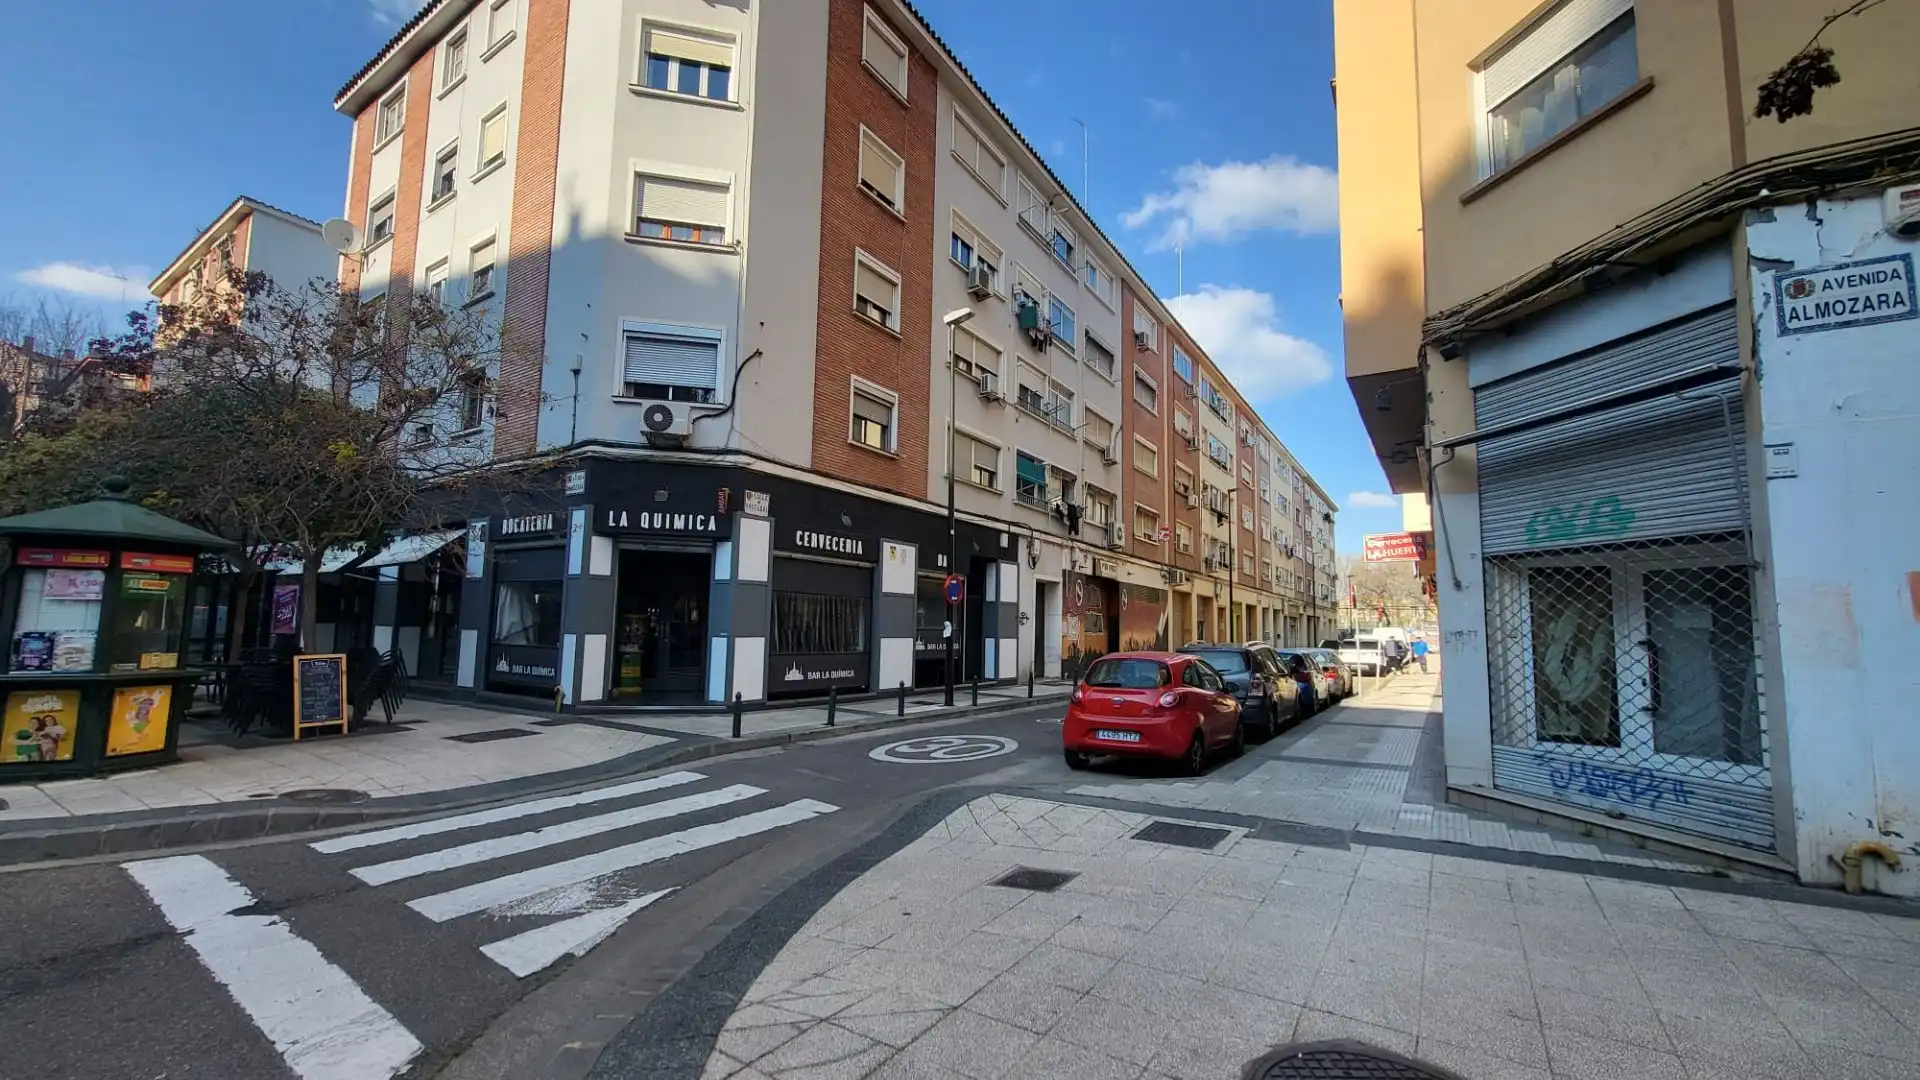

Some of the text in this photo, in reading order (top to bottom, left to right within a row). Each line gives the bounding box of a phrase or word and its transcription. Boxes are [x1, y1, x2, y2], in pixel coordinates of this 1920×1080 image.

[1821, 267, 1902, 292] AVENIDA
[1788, 291, 1907, 324] ALMOZARA
[608, 510, 716, 532] LA QUIMICA
[795, 530, 863, 555] CERVECERIA
[1382, 546, 1424, 557] HUERTA
[937, 553, 948, 567] BA
[523, 665, 531, 675] LA
[807, 671, 820, 680] BAR
[821, 671, 830, 679] LA
[894, 738, 1001, 759] 30
